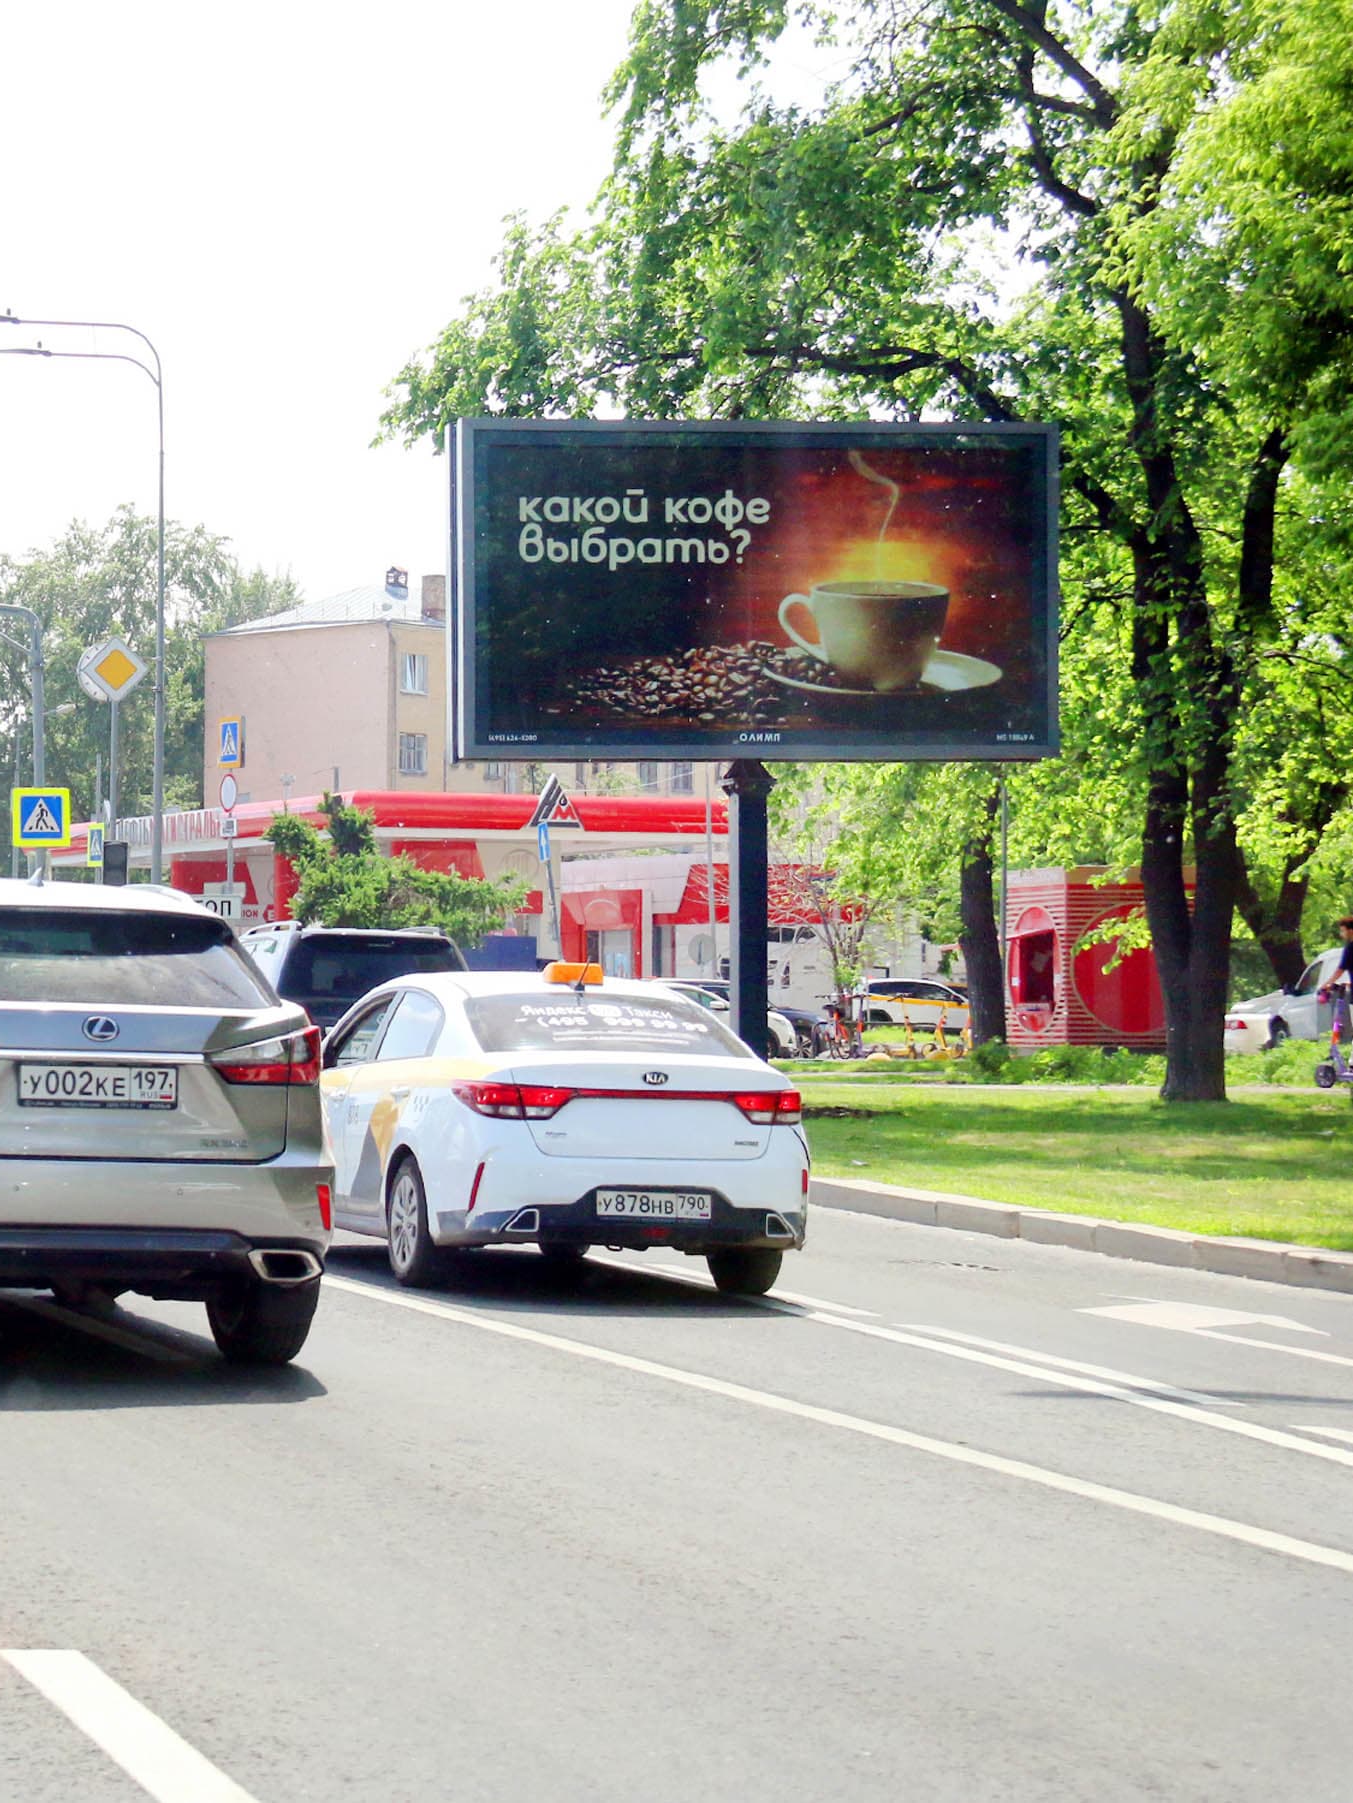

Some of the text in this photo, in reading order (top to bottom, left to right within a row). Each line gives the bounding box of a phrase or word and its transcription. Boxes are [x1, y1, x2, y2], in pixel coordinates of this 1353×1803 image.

[519, 488, 771, 531] какой кофе
[518, 522, 752, 572] выбрать?
[739, 733, 780, 742] ОЛИМП
[30, 1069, 169, 1097] У002КЕ 197
[603, 1194, 705, 1214] У878НВ 790
